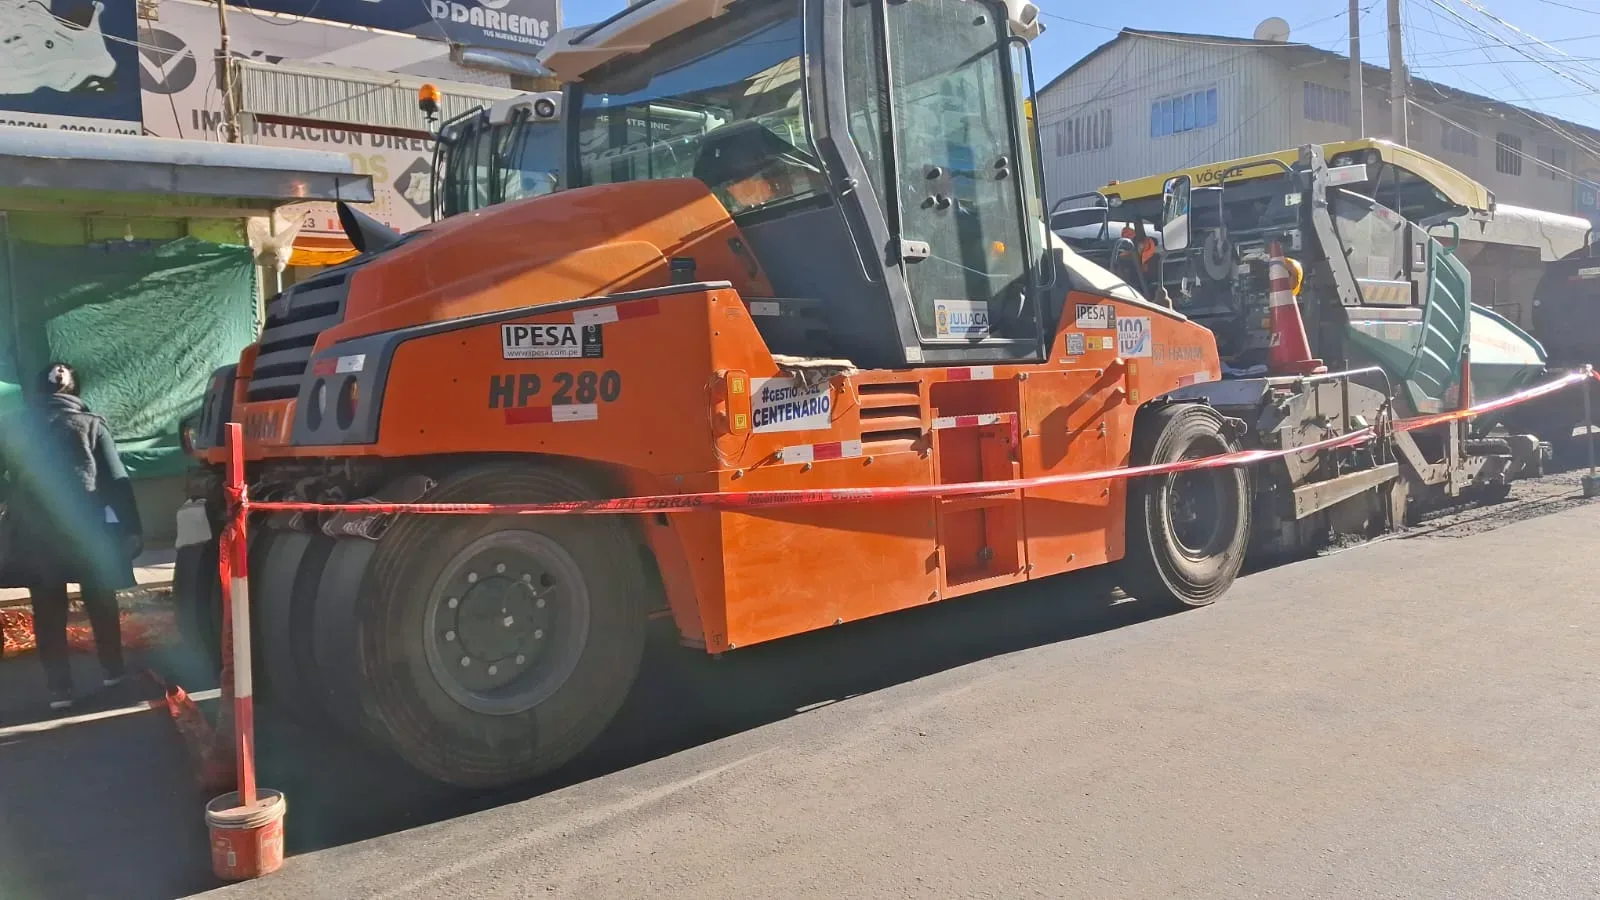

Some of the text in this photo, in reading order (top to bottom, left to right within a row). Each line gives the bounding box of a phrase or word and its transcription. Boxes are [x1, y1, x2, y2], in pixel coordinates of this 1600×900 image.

[949, 311, 988, 326] JULIACA
[1077, 305, 1106, 321] IPESA
[505, 326, 578, 347] IPESA
[488, 369, 621, 409] HP 280
[753, 395, 830, 428] CENTENARIO
